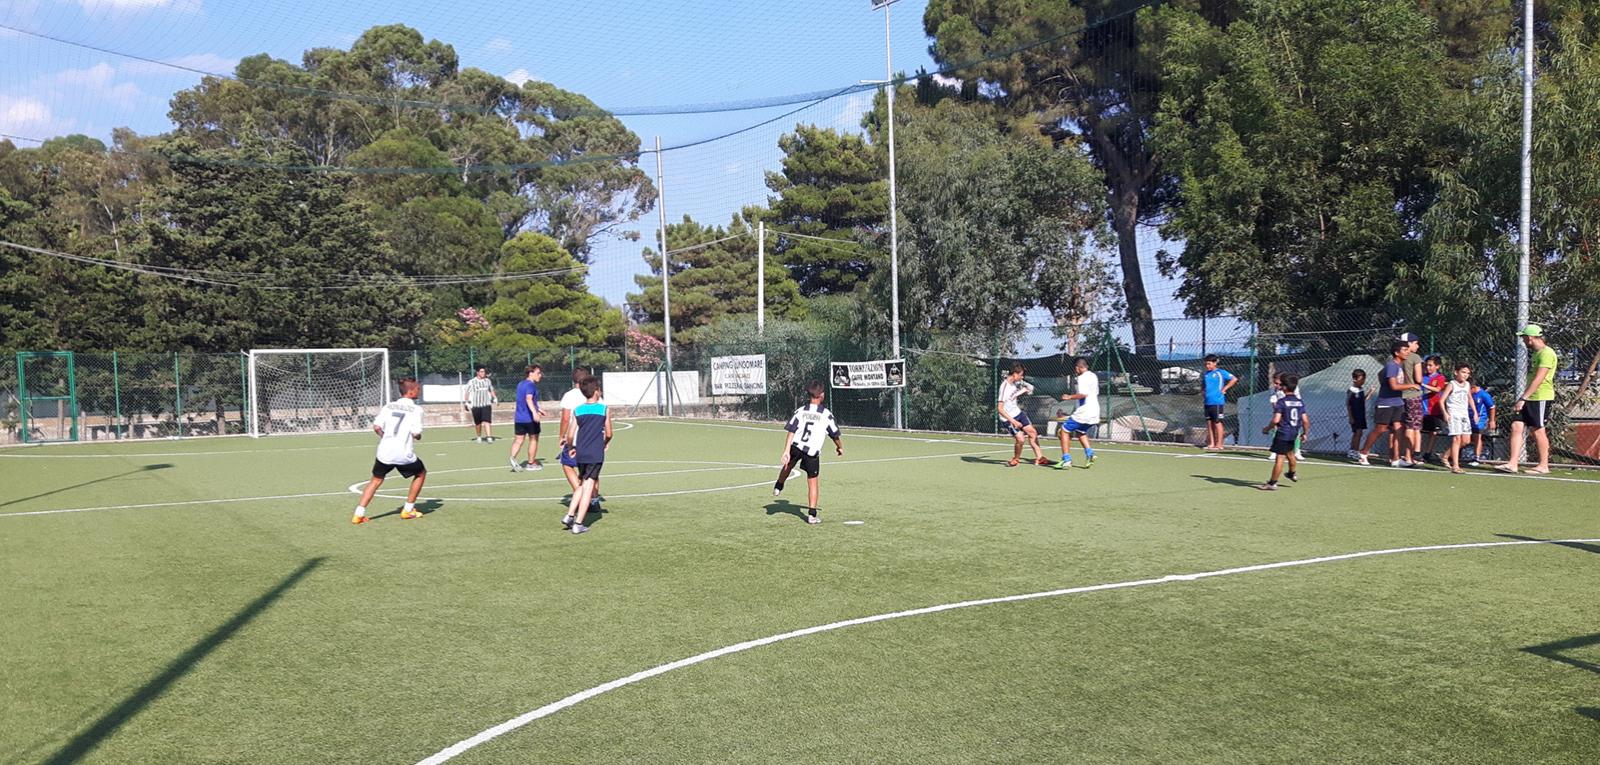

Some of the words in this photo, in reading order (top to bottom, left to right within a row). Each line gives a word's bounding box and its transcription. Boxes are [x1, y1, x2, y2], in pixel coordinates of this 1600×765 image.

[713, 361, 733, 370] CAMPING
[734, 359, 763, 369] LUNGOMARE
[392, 412, 405, 437] 7
[1290, 408, 1299, 426] 9
[801, 421, 815, 442] 6
